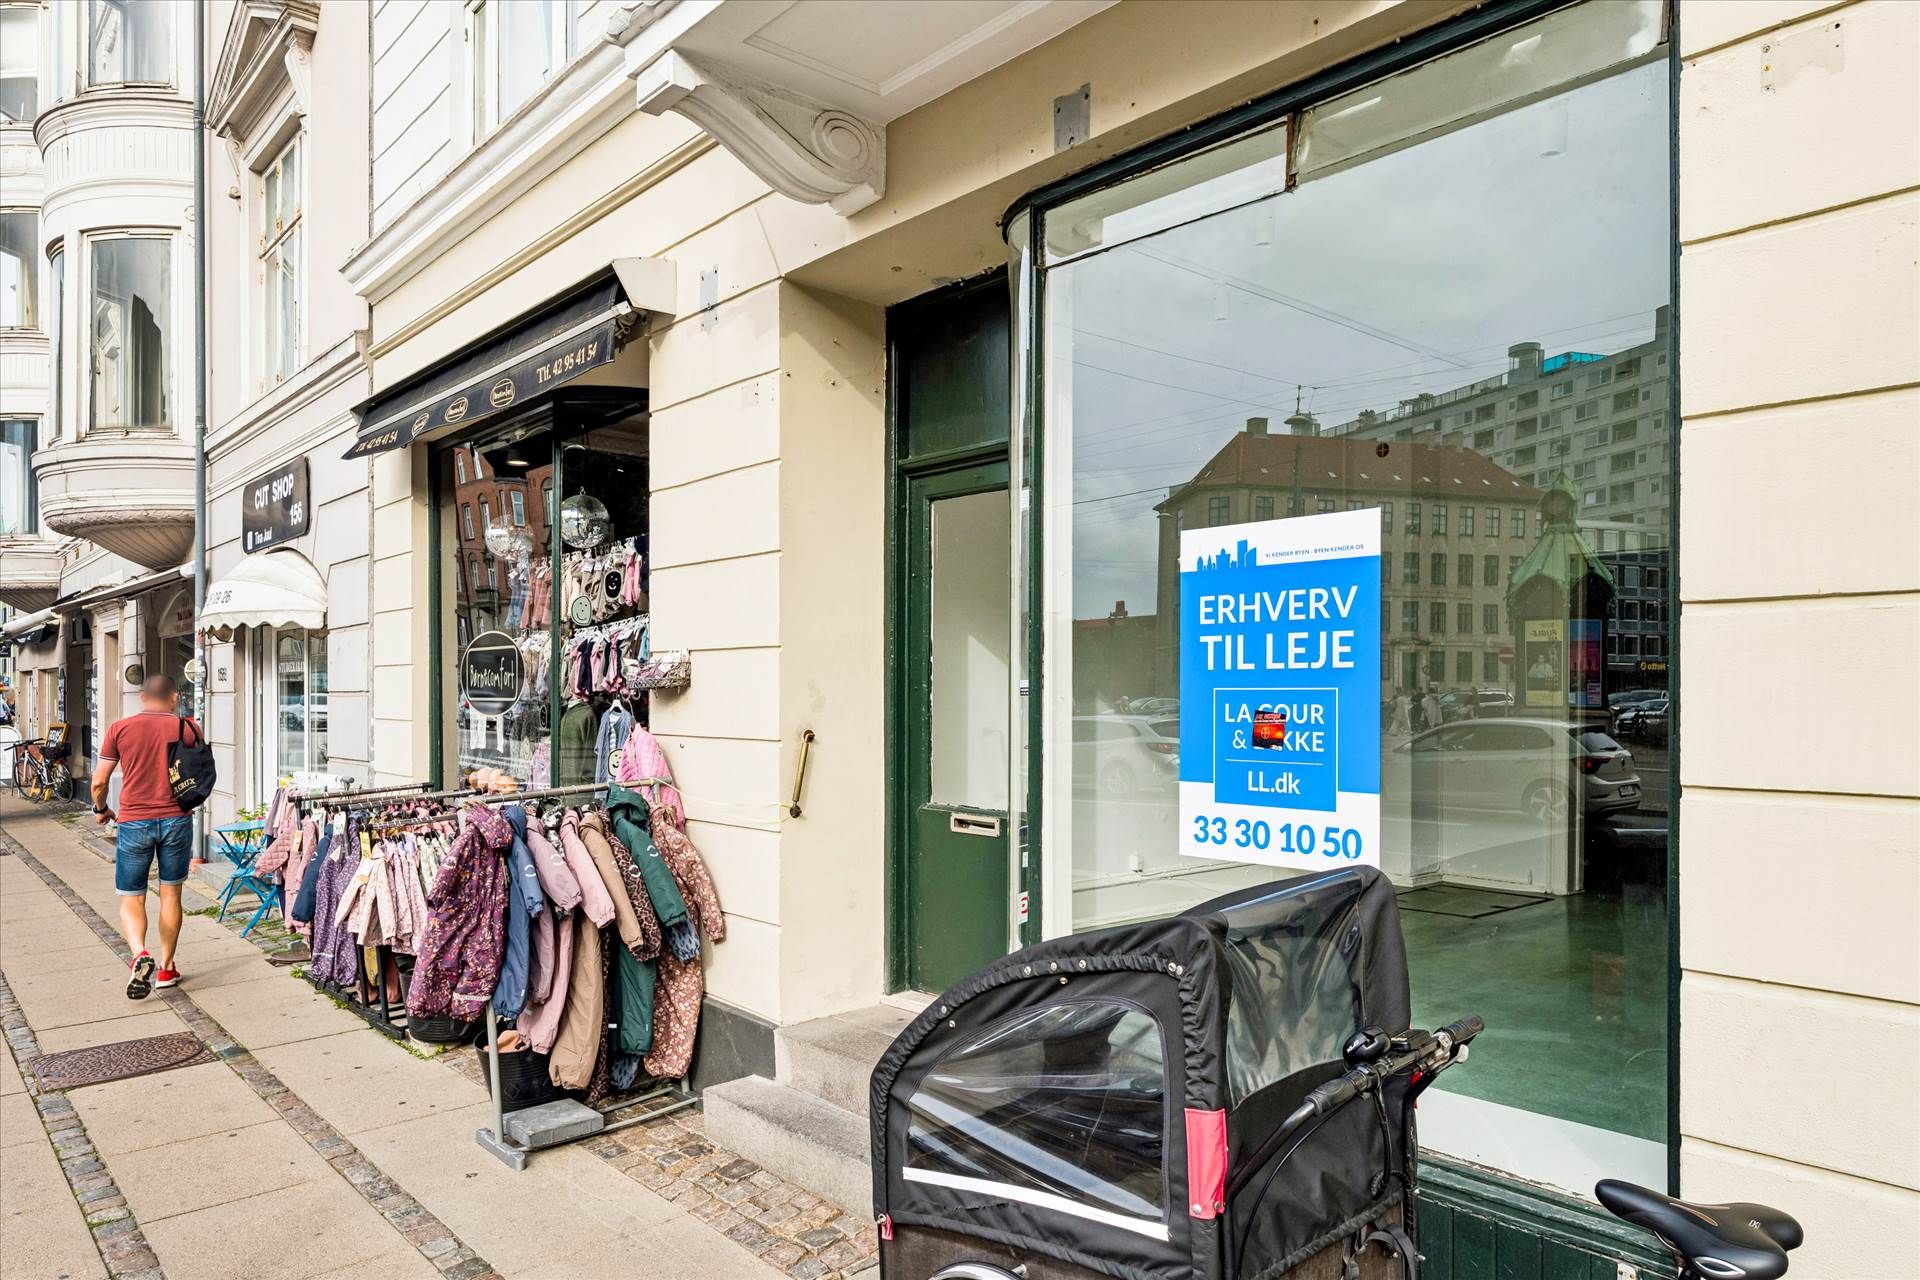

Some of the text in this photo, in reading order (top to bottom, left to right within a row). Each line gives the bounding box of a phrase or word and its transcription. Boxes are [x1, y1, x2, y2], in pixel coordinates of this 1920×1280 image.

[553, 358, 563, 376] 42
[564, 352, 575, 372] 95
[576, 347, 586, 365] 41
[587, 341, 598, 361] 54
[254, 472, 294, 510] CUT SHOP
[290, 501, 302, 526] 156
[1199, 585, 1358, 625] ERHVERV
[1200, 630, 1355, 671] TIL LEJE
[1224, 703, 1253, 723] LA
[1232, 729, 1325, 752] & KKE
[1248, 771, 1301, 794] LL.dk
[1193, 815, 1362, 860] 33 30 10 50
